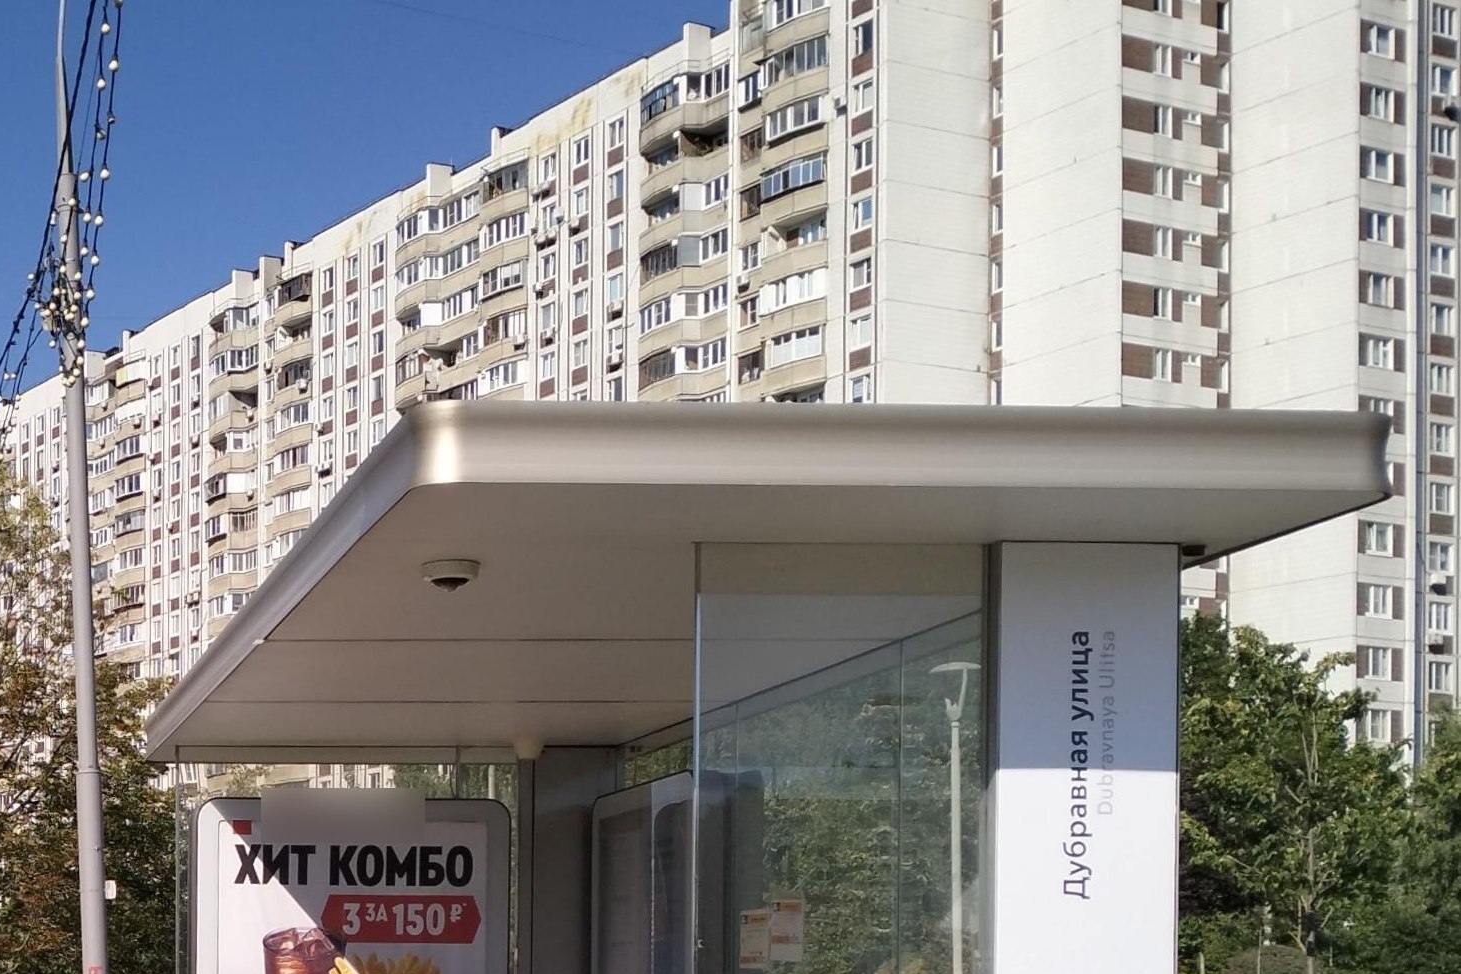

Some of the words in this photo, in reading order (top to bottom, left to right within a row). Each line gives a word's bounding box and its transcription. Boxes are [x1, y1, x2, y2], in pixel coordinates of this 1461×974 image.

[1071, 631, 1094, 721] улица
[1097, 630, 1115, 688] Ulitsa
[1097, 695, 1117, 815] Dubravnaya
[1063, 730, 1092, 899] Дубравная
[234, 843, 316, 886] ХИТ
[329, 844, 474, 888] КОМБО
[342, 902, 361, 936] 3
[365, 903, 388, 922] ЗА
[392, 903, 446, 936] 150
